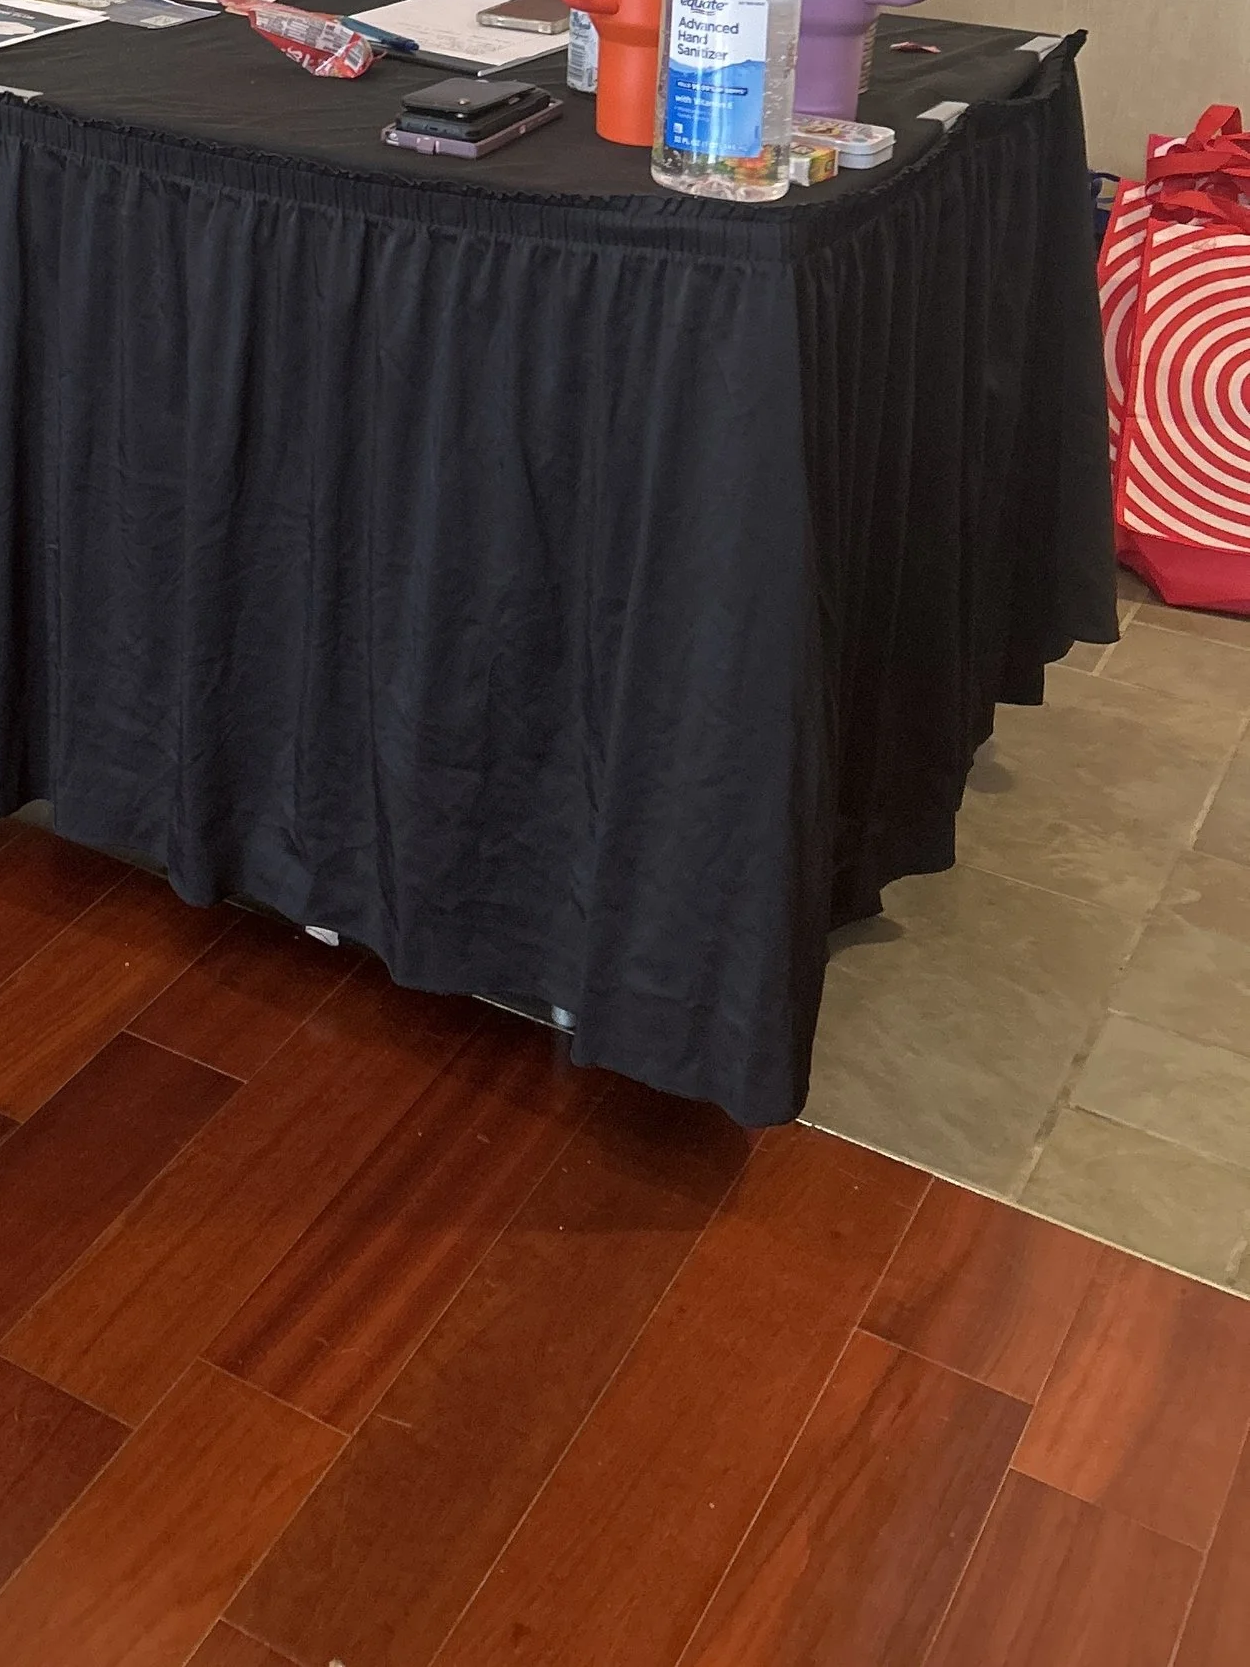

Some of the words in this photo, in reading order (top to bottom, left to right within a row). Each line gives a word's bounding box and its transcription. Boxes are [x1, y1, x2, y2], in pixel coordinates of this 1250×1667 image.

[678, 16, 740, 34] Advanced
[677, 29, 708, 45] Hand
[677, 43, 729, 61] Sanitizer
